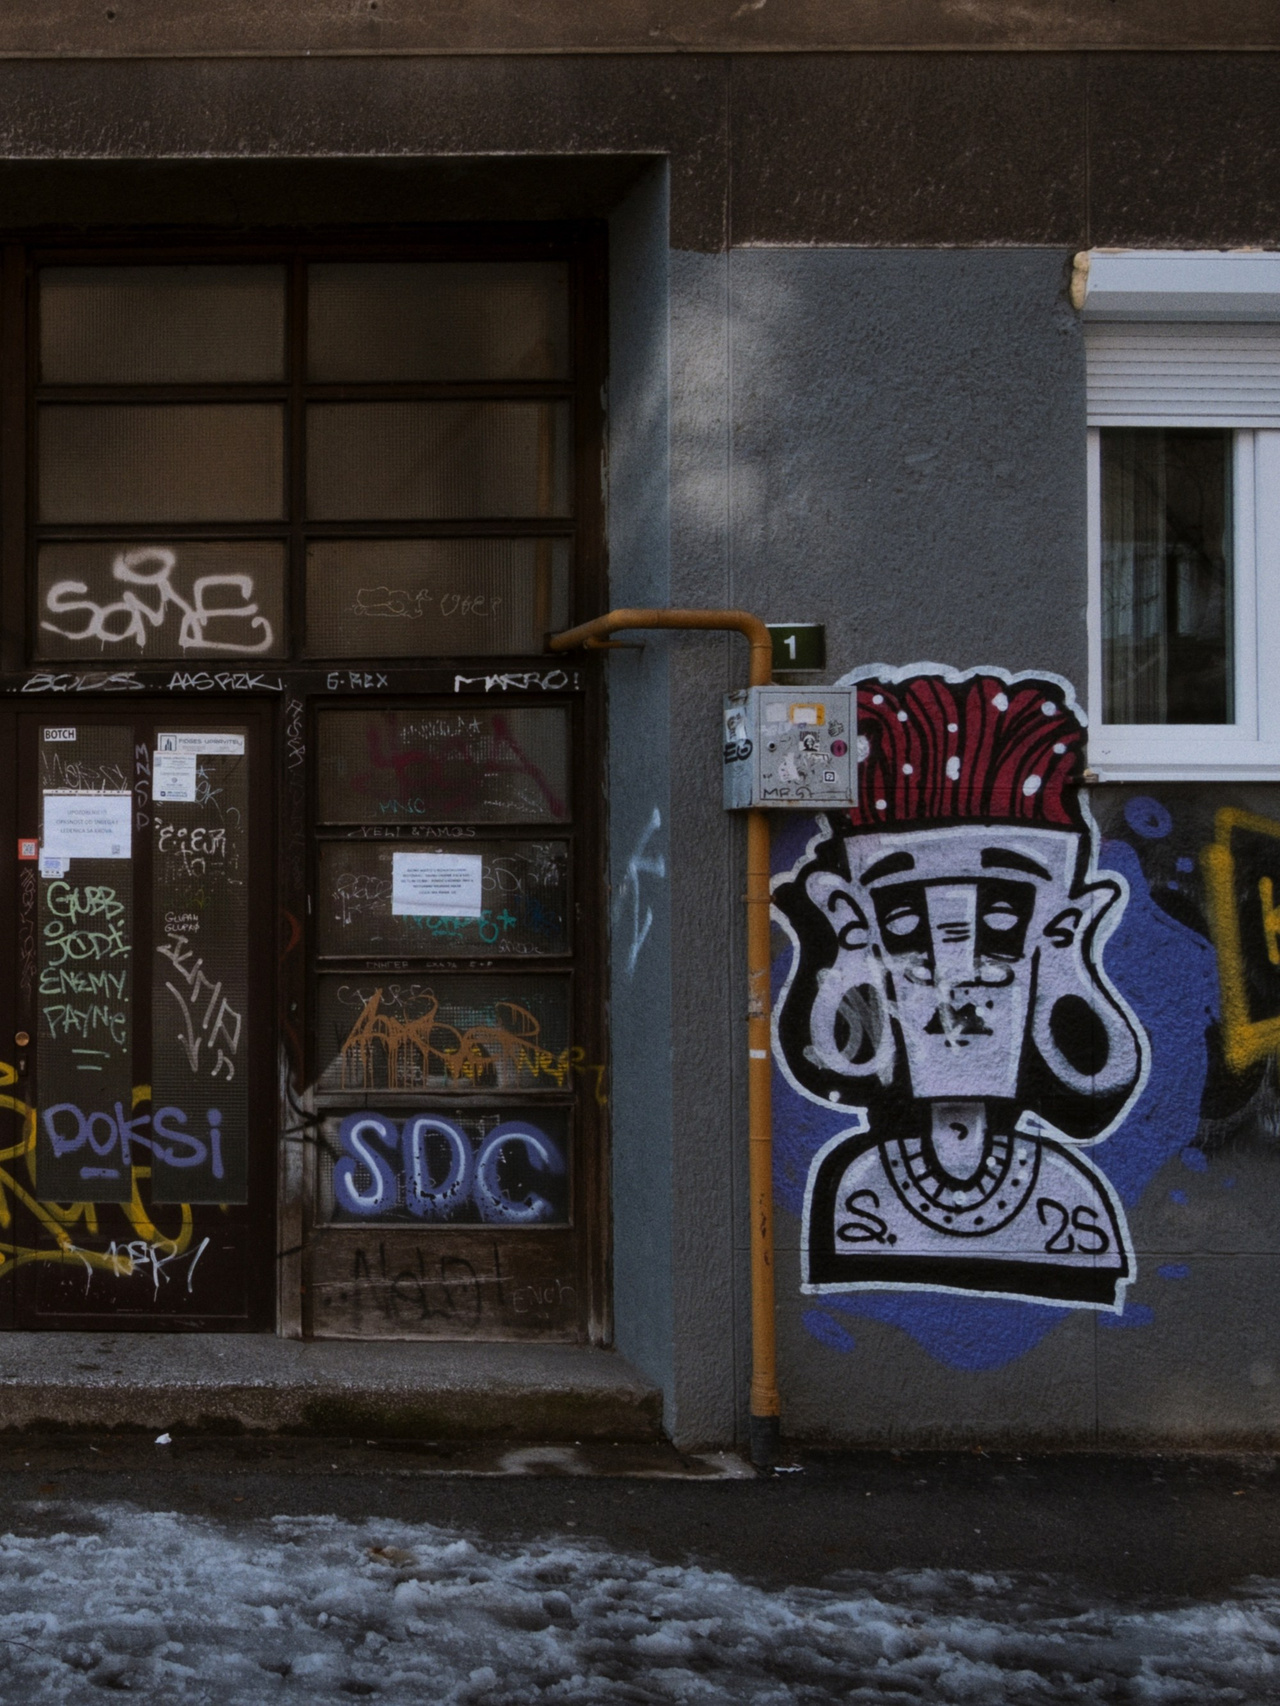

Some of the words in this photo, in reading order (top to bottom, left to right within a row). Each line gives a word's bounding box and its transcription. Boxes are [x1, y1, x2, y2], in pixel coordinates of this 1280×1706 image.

[783, 635, 796, 660] 1
[44, 729, 75, 740] BOTCH
[334, 1111, 568, 1224] SDC
